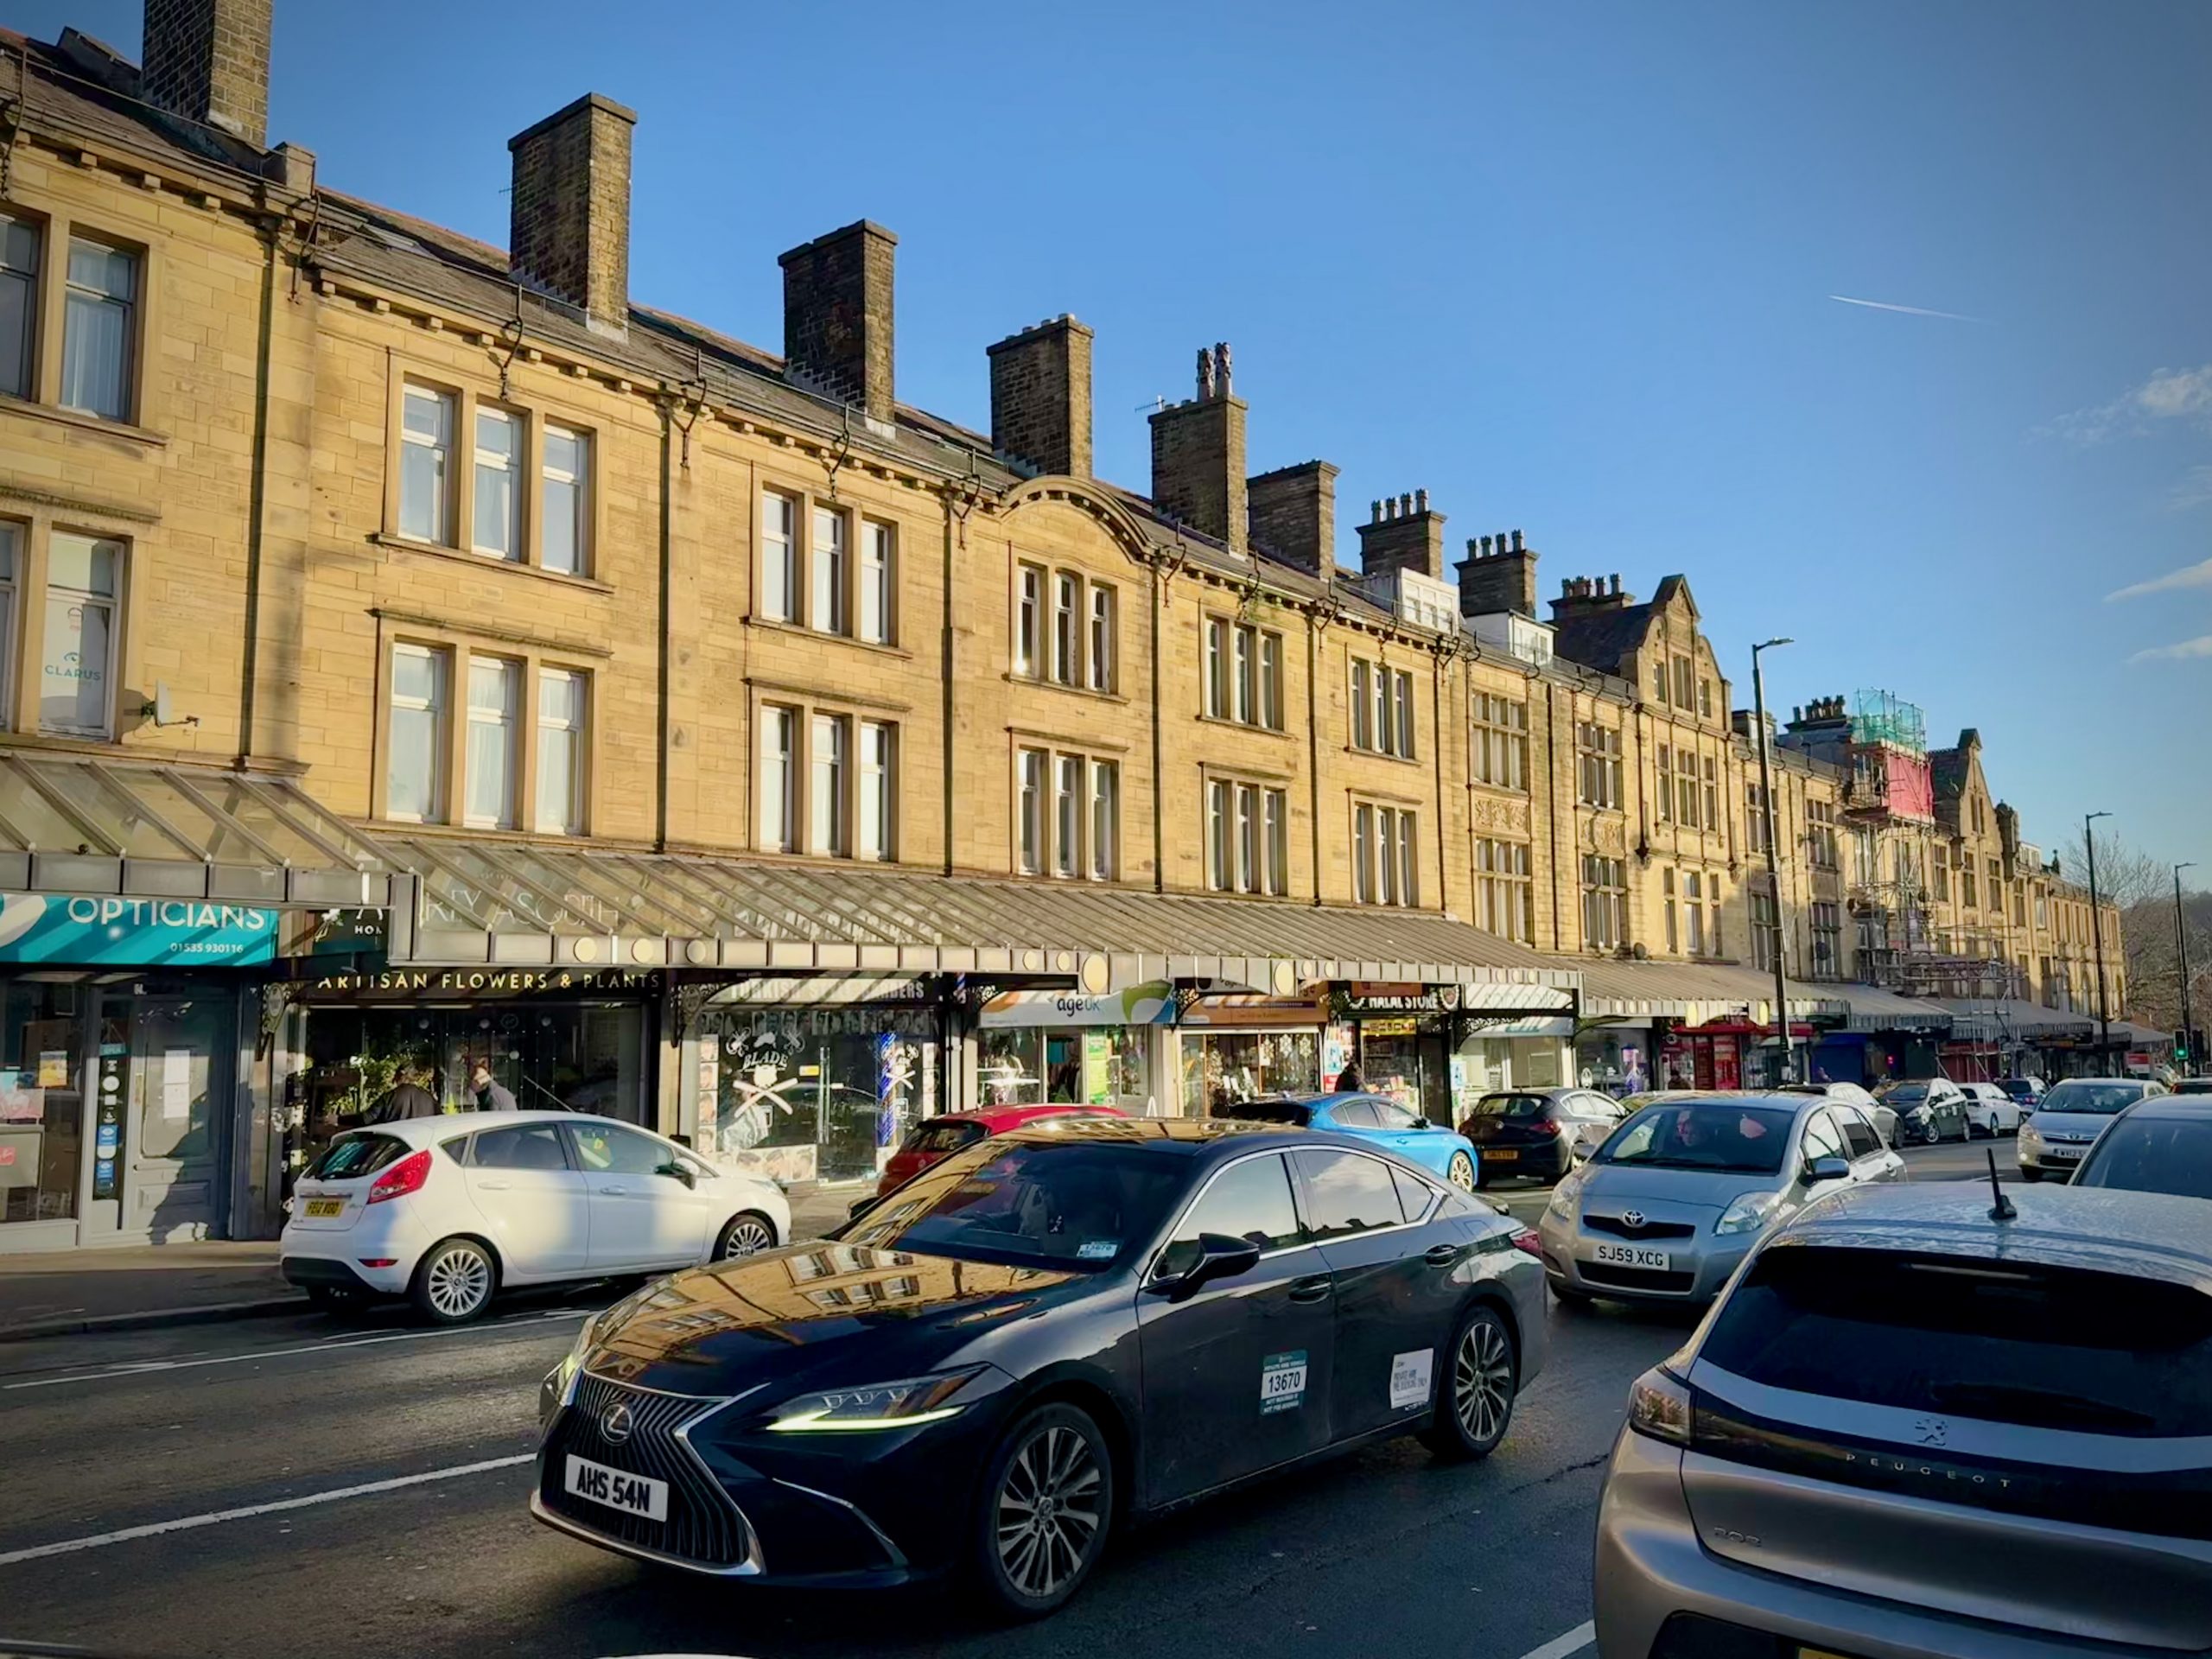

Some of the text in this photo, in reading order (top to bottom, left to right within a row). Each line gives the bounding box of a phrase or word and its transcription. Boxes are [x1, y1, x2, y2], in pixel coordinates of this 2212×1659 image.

[45, 664, 102, 681] CLARUS
[68, 896, 265, 930] OPTICIANS
[442, 973, 548, 989] FLOWERS
[559, 973, 572, 988] &
[583, 974, 659, 988] PLANTS
[1057, 998, 1101, 1017] age UK
[741, 1049, 789, 1070] BLADE
[1599, 1245, 1663, 1267] SJ59 XCG
[1268, 1371, 1301, 1394] 13670
[1845, 1453, 2012, 1489] PEUGEOT
[576, 1465, 652, 1513] AHS 54N
